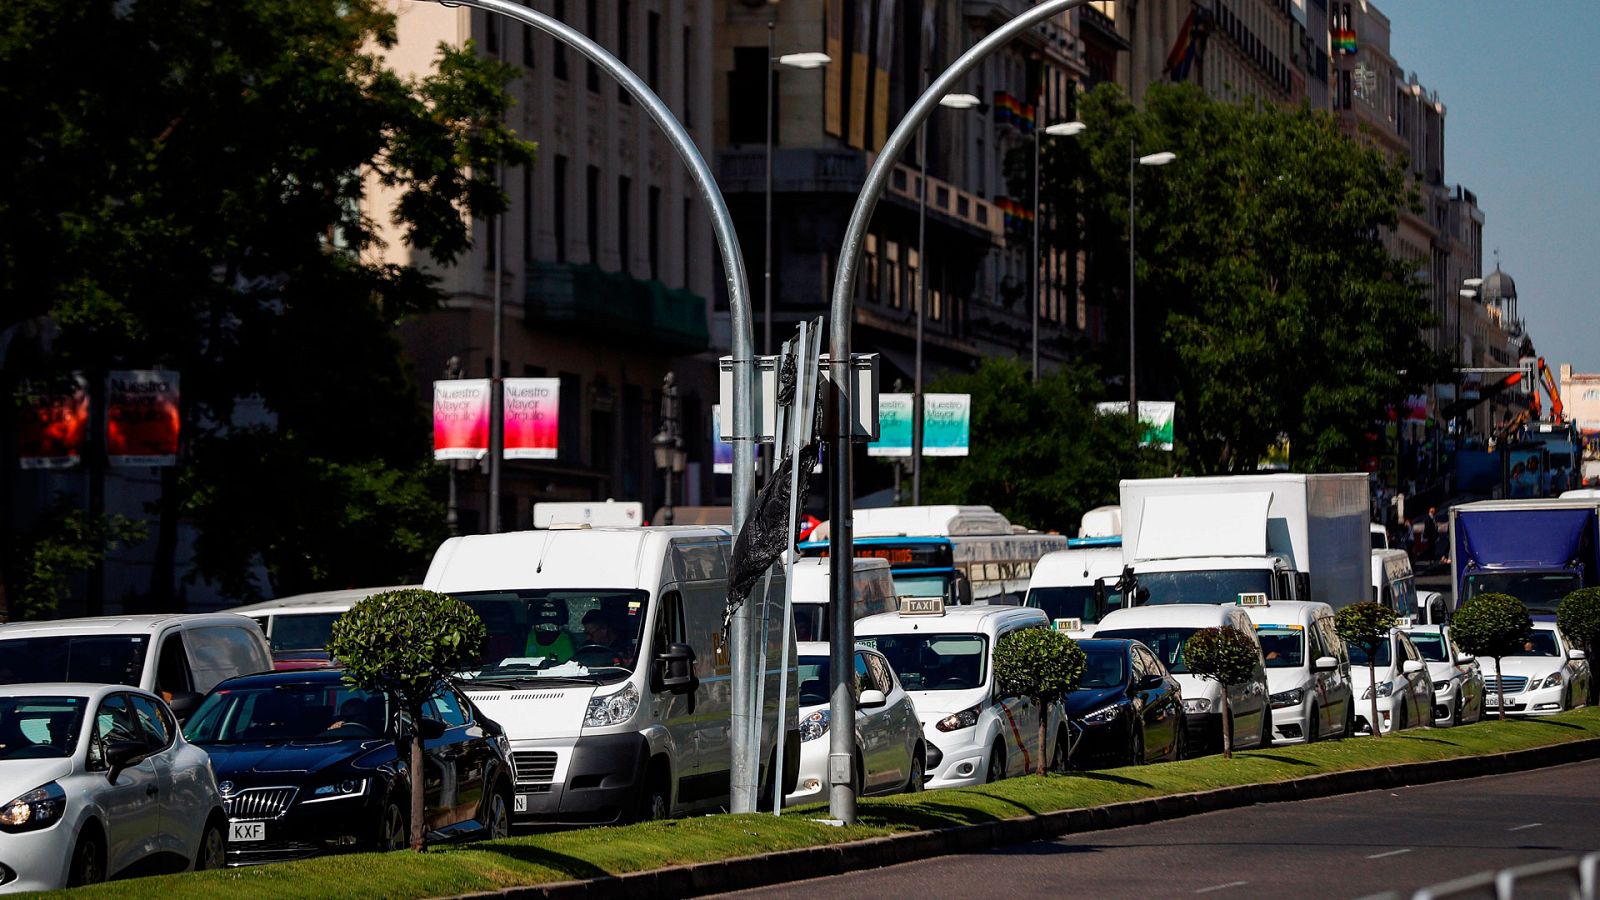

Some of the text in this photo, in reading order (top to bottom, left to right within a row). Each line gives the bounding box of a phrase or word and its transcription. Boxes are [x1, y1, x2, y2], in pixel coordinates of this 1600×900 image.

[112, 379, 169, 392] Nuestro
[436, 388, 480, 399] Nuestro
[507, 387, 549, 398] Nuestro
[436, 400, 470, 411] Mayor
[507, 399, 539, 410] Mayor
[927, 401, 962, 409] Nuestro
[436, 411, 475, 423] Orgullo
[507, 410, 545, 422] Orgullo
[880, 410, 896, 419] ayor
[927, 410, 954, 419] Mayor
[911, 601, 932, 610] TAXI
[1244, 596, 1257, 604] TAXI
[1059, 621, 1071, 629] TAXI
[234, 825, 261, 839] KXF
